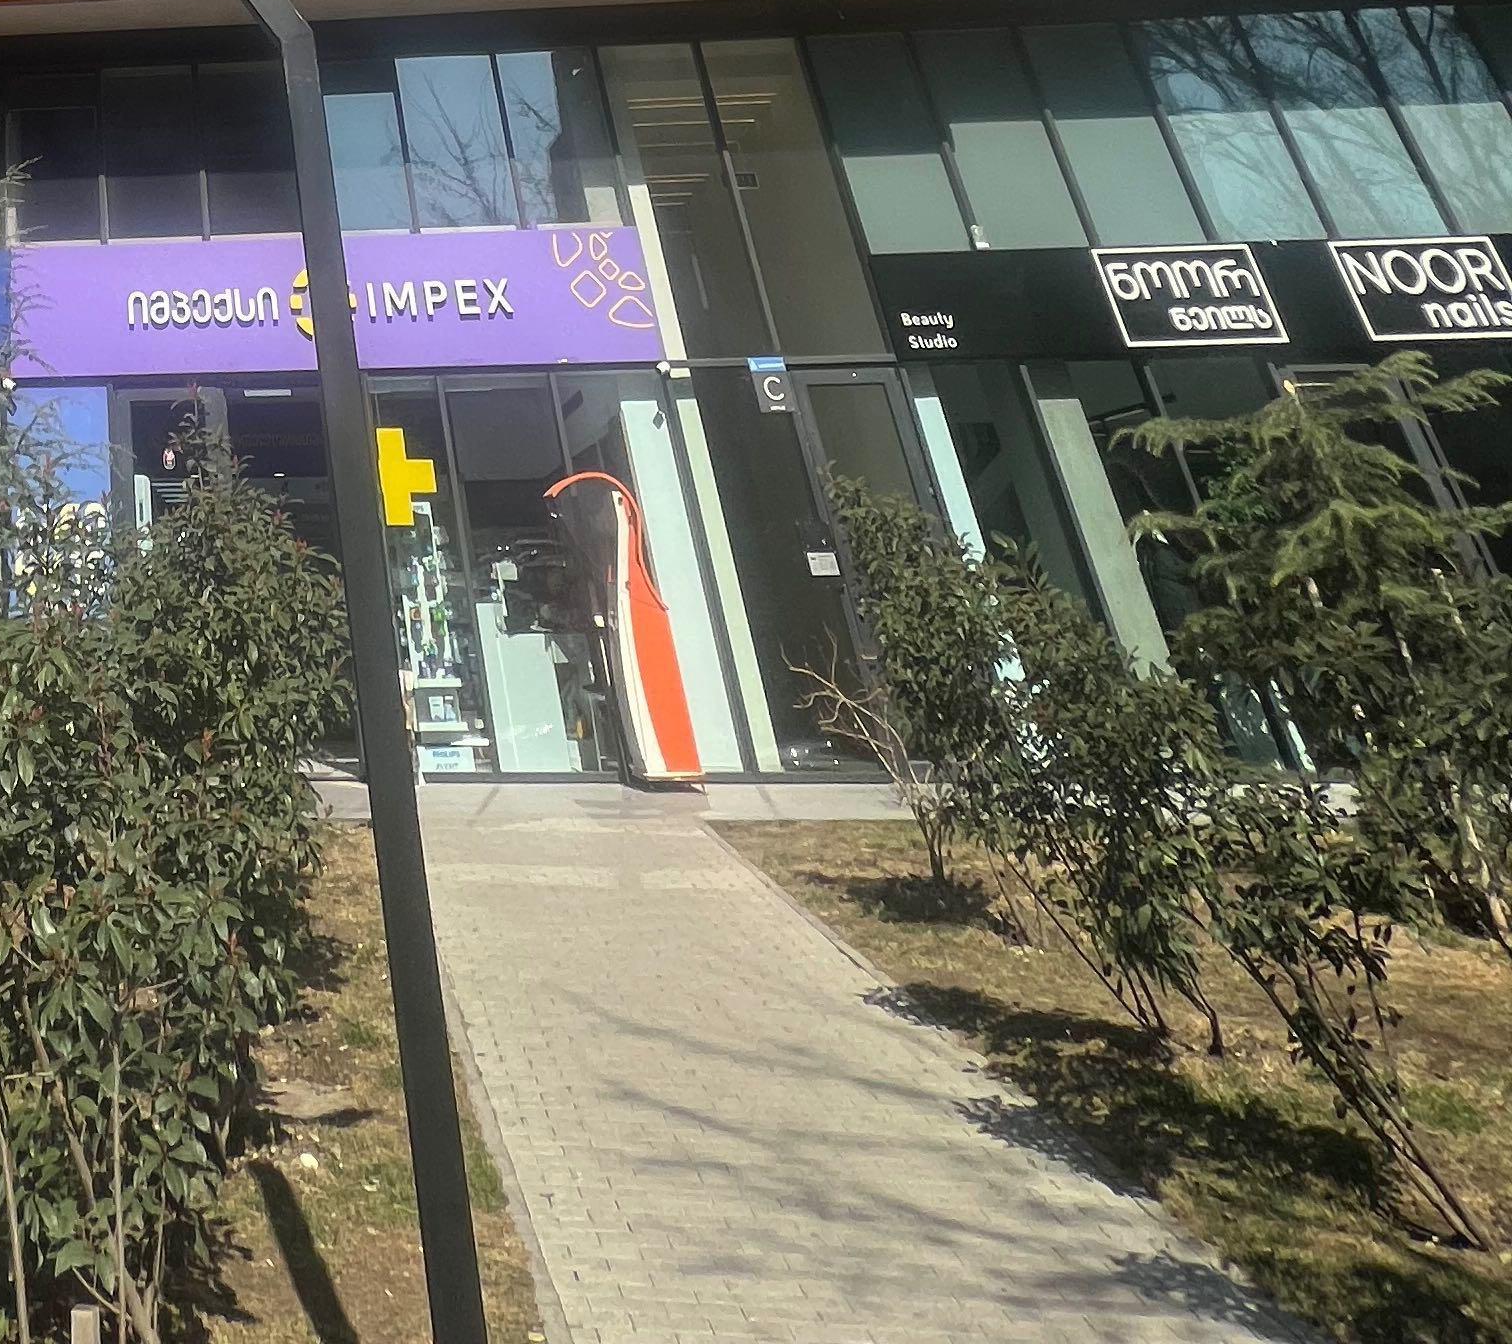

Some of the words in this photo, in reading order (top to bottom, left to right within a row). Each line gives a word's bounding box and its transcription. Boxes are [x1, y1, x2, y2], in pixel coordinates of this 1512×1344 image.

[1104, 258, 1261, 301] ნოორ
[1341, 248, 1506, 296] NOOR
[127, 286, 280, 329] იმპექსი
[365, 277, 516, 322] IMPEX
[900, 312, 954, 329] Beauty
[908, 333, 958, 349] Studio
[763, 376, 785, 401] C
